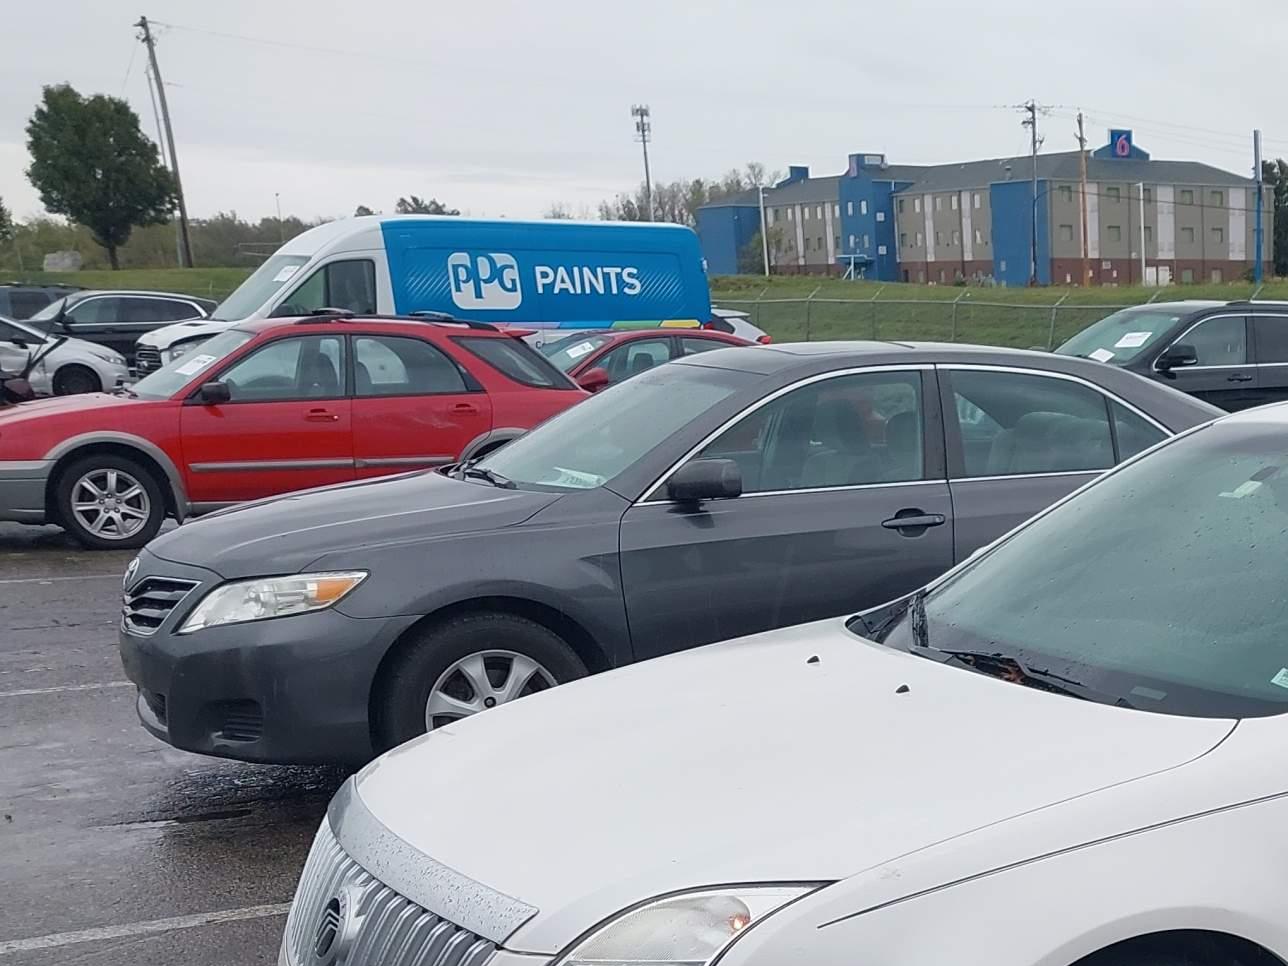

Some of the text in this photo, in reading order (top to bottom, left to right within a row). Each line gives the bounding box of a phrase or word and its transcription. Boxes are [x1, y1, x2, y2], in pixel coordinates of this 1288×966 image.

[1116, 133, 1130, 157] 6
[451, 253, 642, 299] PPG PAINTS
